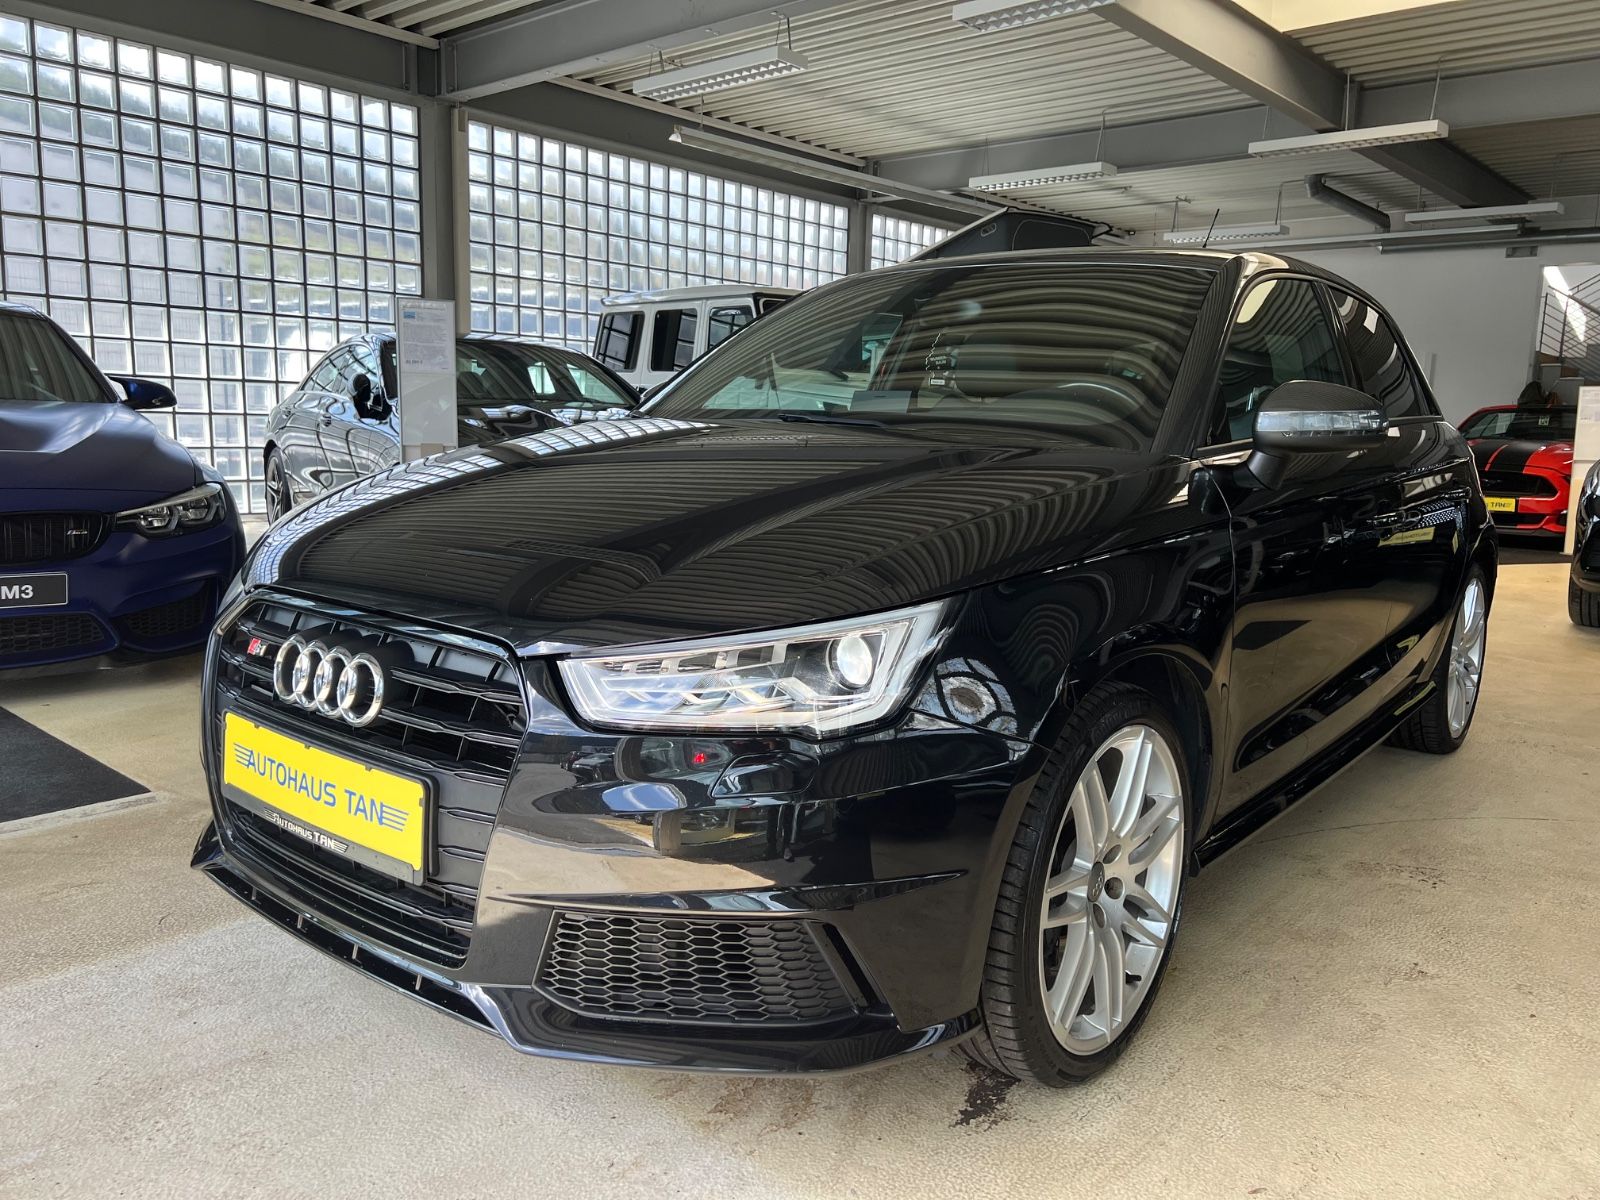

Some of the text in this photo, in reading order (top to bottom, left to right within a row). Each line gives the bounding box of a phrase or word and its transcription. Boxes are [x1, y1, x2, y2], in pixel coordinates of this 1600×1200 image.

[1, 584, 34, 599] M3
[247, 750, 384, 825] AUTOHAUS TAN
[313, 831, 336, 849] TAN
